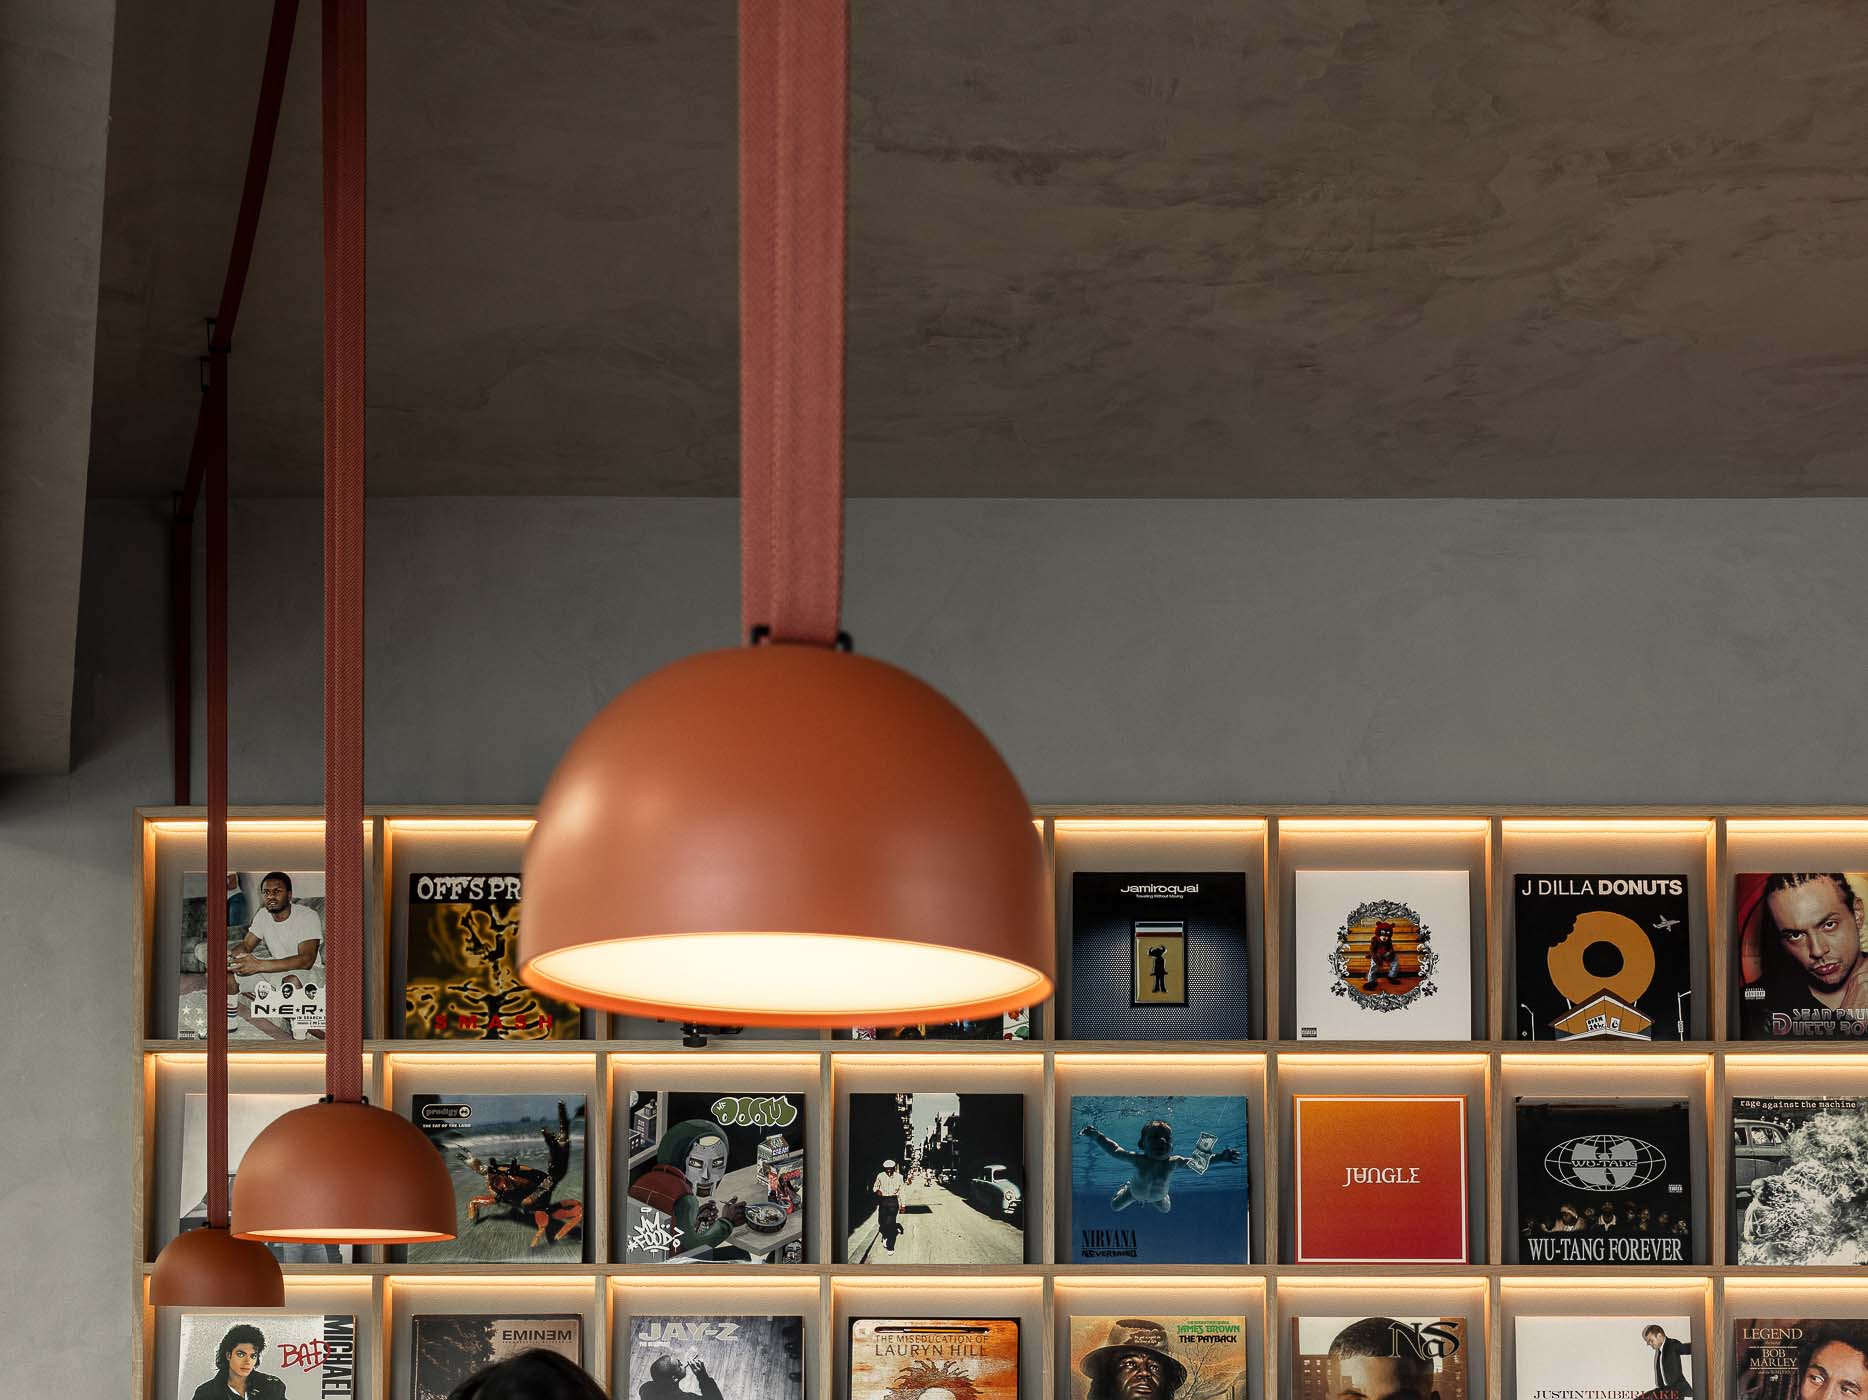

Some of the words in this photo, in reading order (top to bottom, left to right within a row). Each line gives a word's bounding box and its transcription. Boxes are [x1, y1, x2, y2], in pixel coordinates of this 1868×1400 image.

[417, 876, 522, 900] OFFSPR
[1120, 883, 1199, 895] Jamiroquai
[1521, 879, 1532, 896] J
[1538, 879, 1594, 896] DILLA
[1598, 879, 1683, 896] DONUTS
[1792, 1008, 1832, 1020] SEAN
[1836, 1008, 1868, 1020] PAU
[434, 1014, 553, 1030] SMASH
[1740, 1100, 1761, 1109] rage
[1762, 1101, 1799, 1110] against
[1801, 1100, 1817, 1108] the
[1819, 1100, 1856, 1108] machine
[1341, 1167, 1422, 1187] JUNGLE
[1081, 1229, 1137, 1248] NIRVANA
[1527, 1238, 1605, 1261] WU-TANG
[1608, 1238, 1684, 1261] FOREVER
[638, 1322, 740, 1341] JAY-Z
[1177, 1324, 1204, 1334] JAMES
[1205, 1324, 1240, 1333] BROWN
[1743, 1328, 1803, 1340] LEGEND
[875, 1335, 893, 1343] THE
[896, 1335, 972, 1344] MISEDUCATION
[975, 1335, 989, 1343] OF
[1179, 1335, 1196, 1343] THE
[1196, 1335, 1237, 1343] PAYBACK
[277, 1338, 332, 1373] BAD
[875, 1344, 943, 1357] LAURYN
[950, 1344, 989, 1356] HILL
[1762, 1348, 1786, 1358] BOB
[321, 1315, 353, 1400] MICHAEL
[1750, 1357, 1798, 1367] MARLEY
